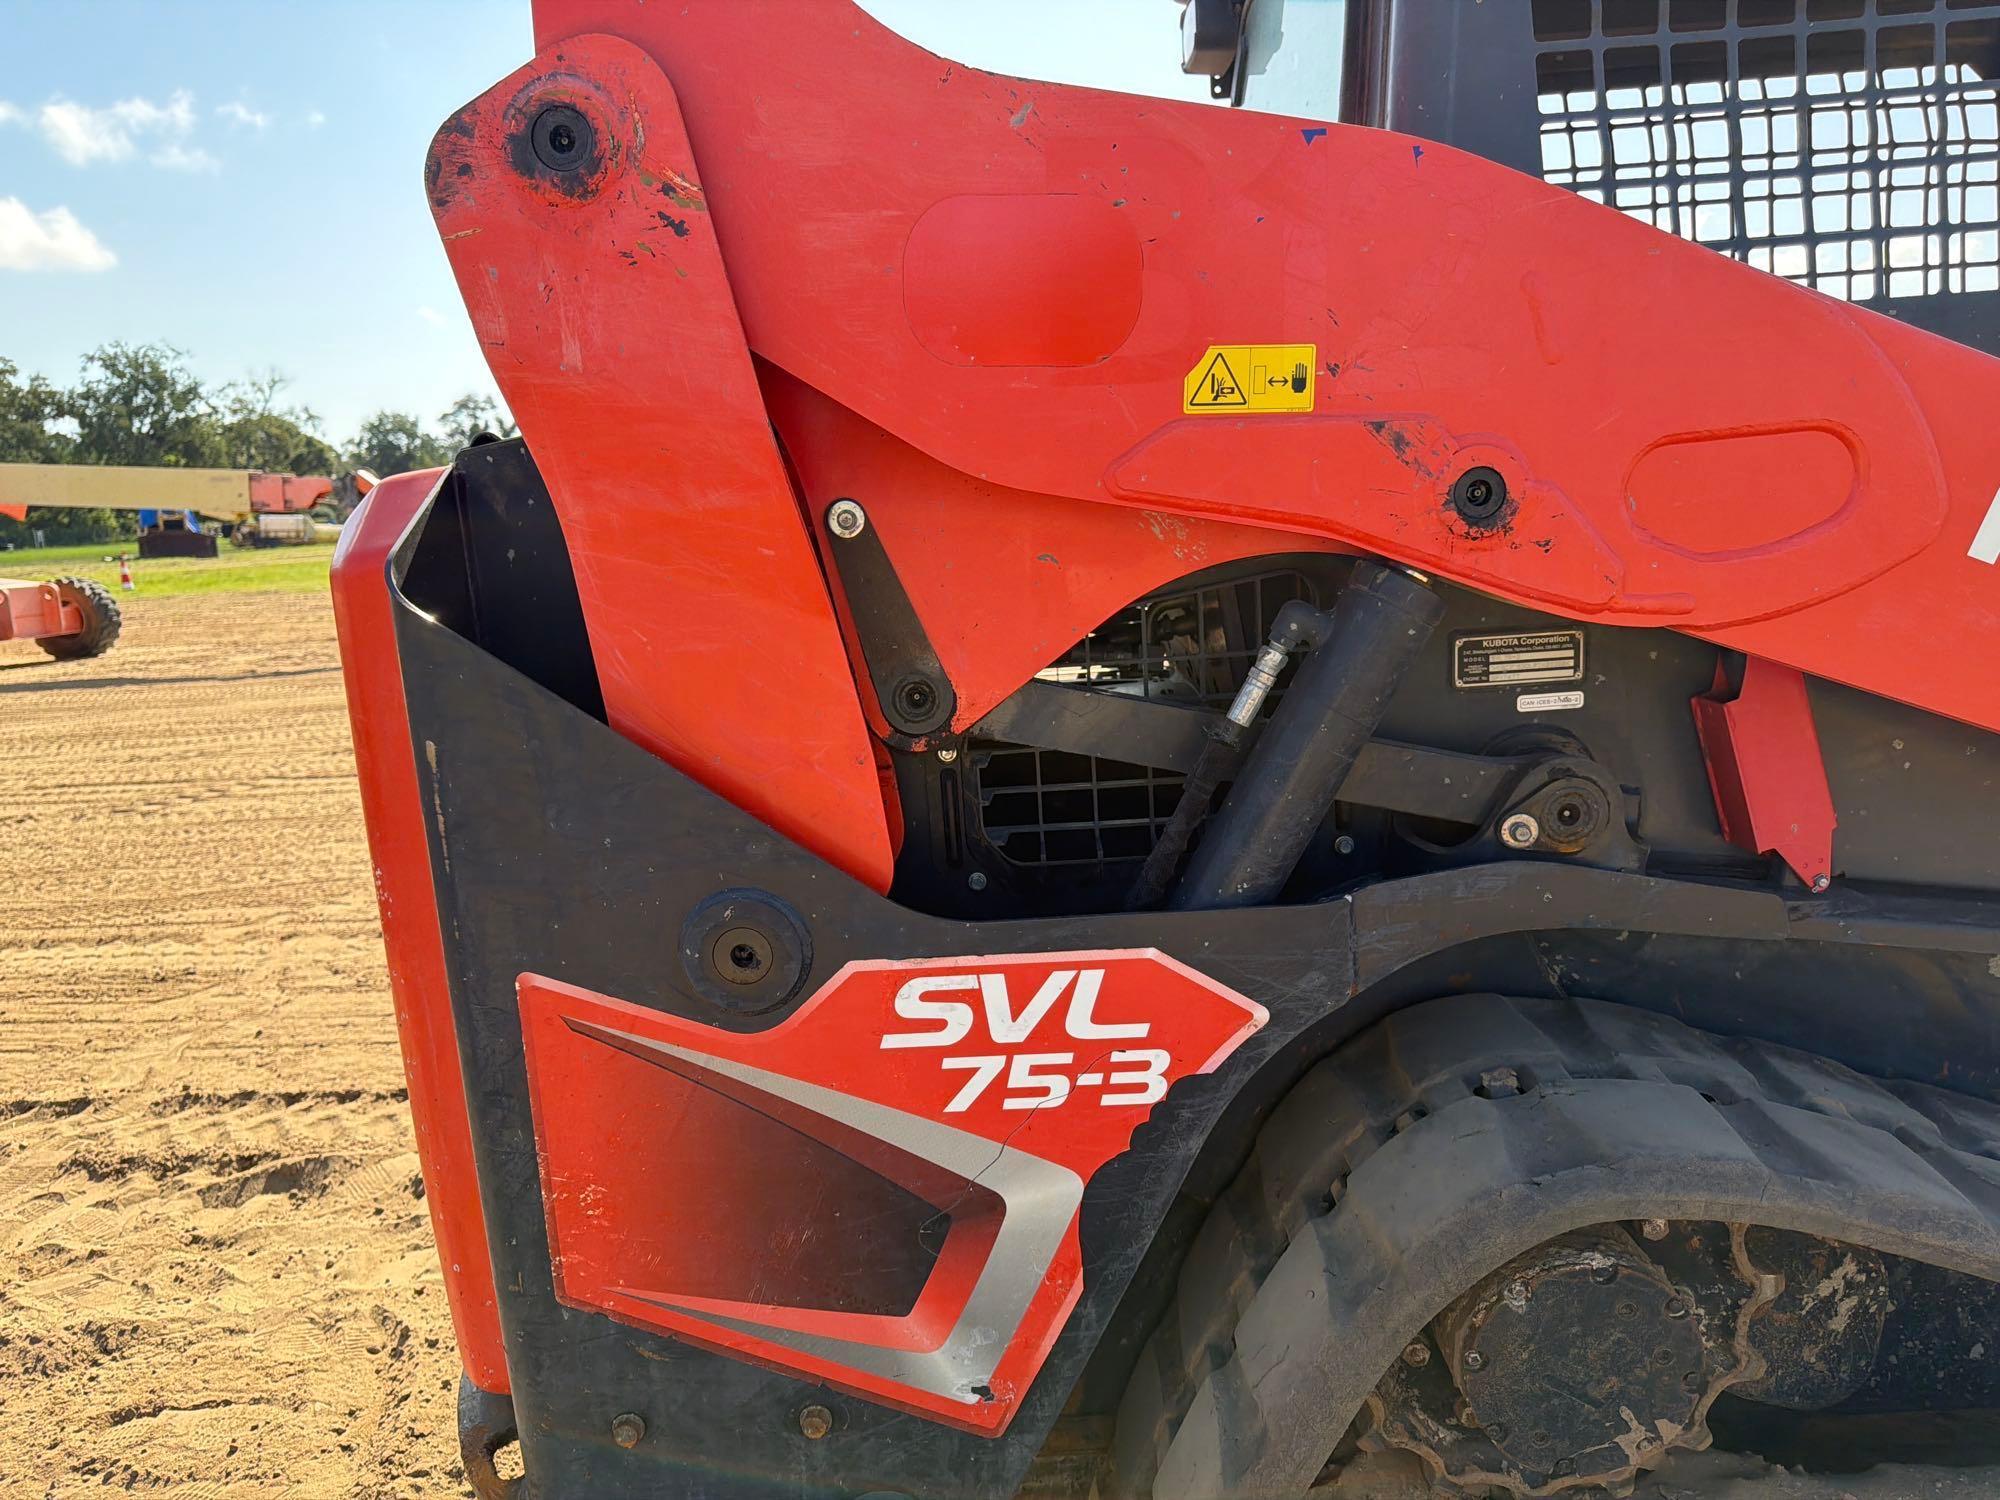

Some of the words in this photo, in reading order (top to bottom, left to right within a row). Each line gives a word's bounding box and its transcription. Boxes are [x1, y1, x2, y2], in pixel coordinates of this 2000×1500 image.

[1483, 639, 1518, 647] KUBOTA
[1520, 636, 1569, 645] Corporation
[879, 968, 1151, 1050] SVL
[941, 1048, 1171, 1113] 75-3
